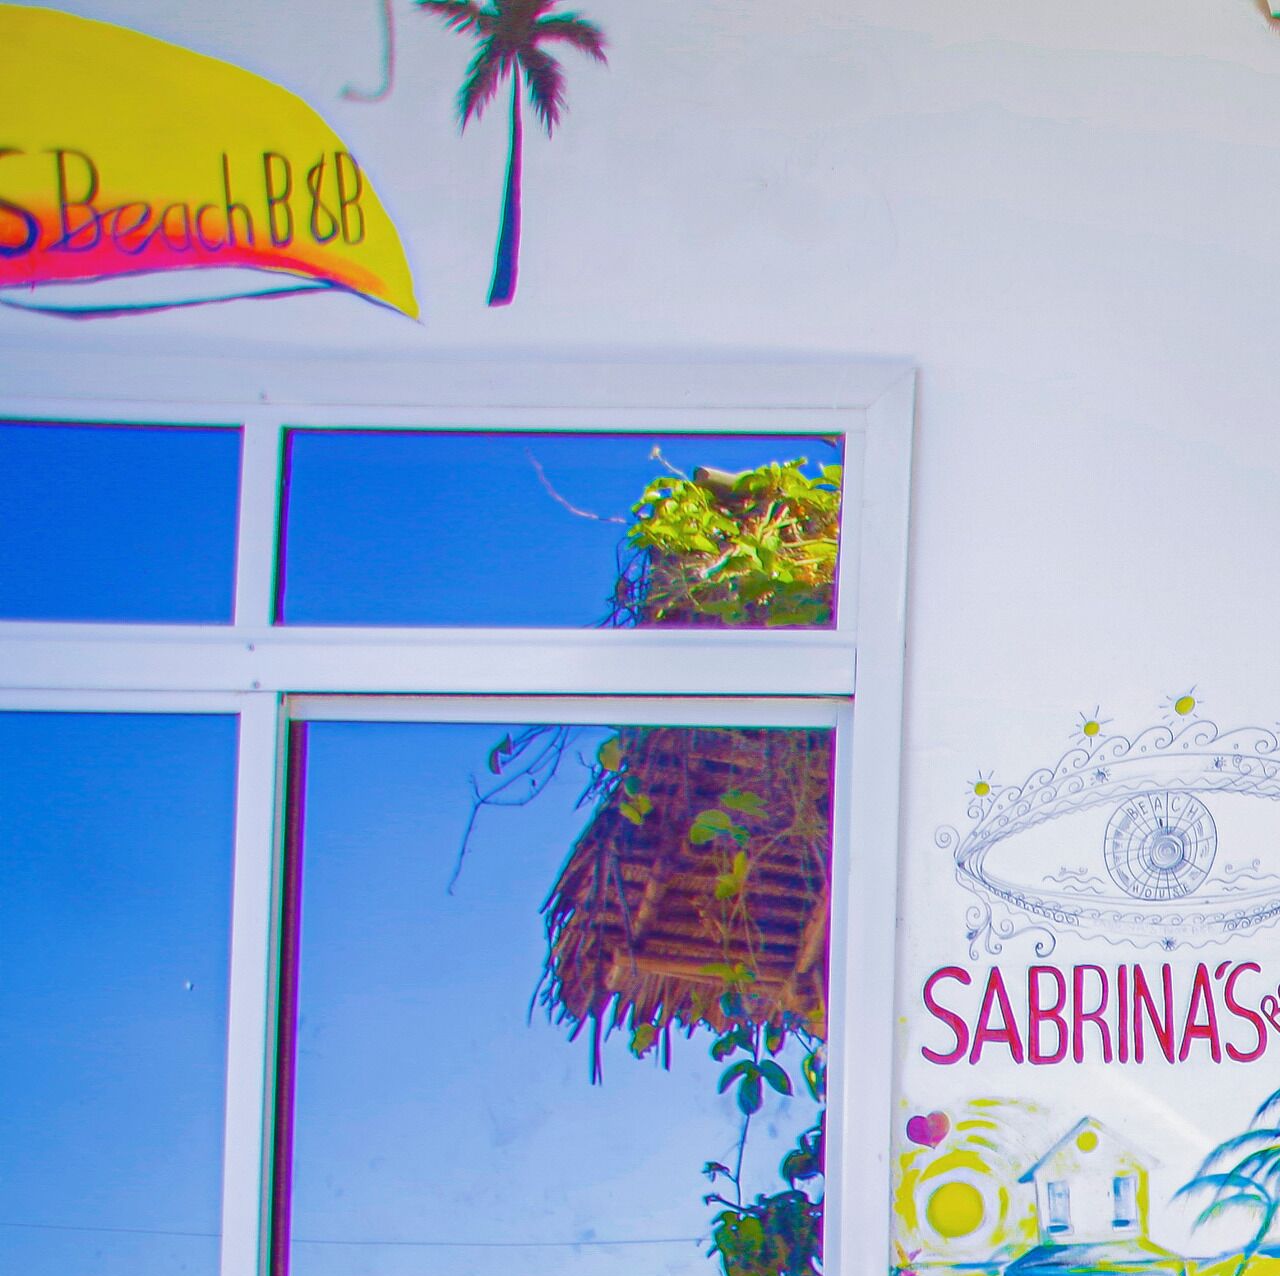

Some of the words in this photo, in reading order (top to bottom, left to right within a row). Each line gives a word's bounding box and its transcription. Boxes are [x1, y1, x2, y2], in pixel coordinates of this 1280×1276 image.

[43, 148, 254, 256] Beach
[1126, 796, 1199, 820] BEACH
[1131, 883, 1191, 898] HOUSE
[921, 961, 1268, 1065] SABRINA'S
